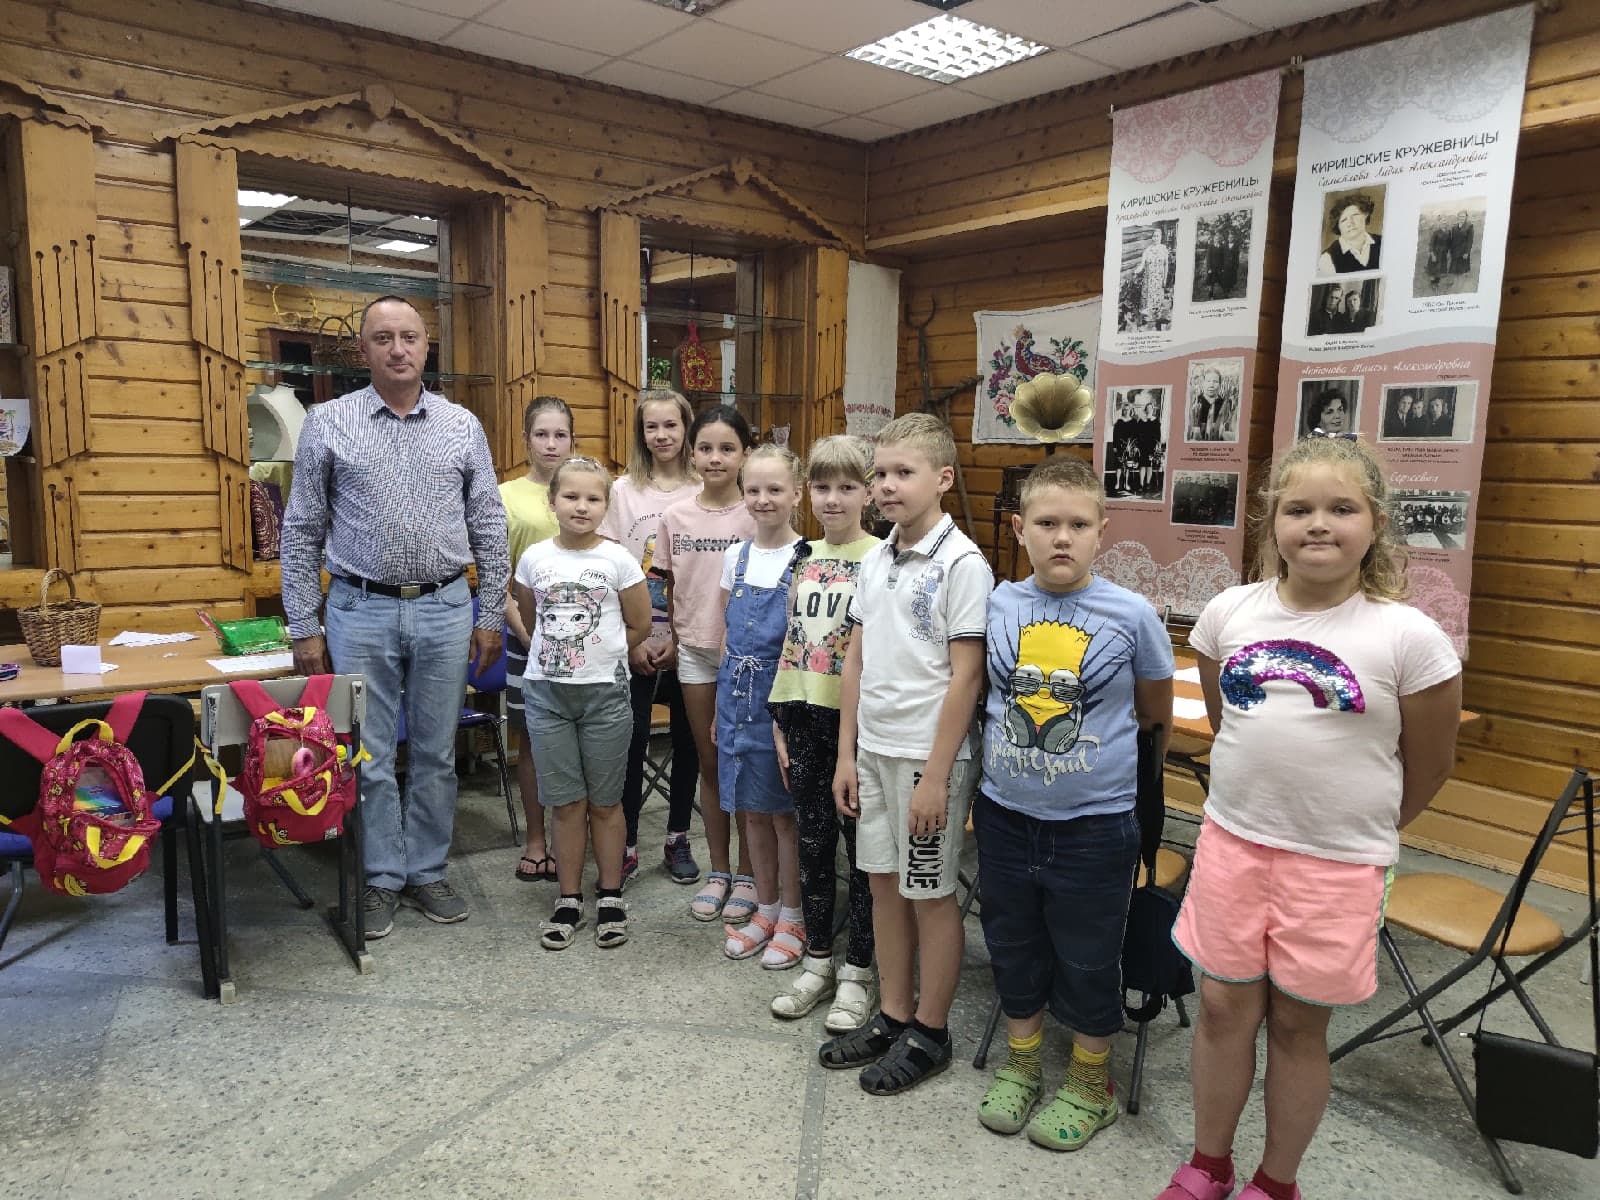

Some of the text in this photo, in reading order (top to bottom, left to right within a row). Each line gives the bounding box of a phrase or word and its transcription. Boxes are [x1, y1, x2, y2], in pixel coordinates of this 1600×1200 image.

[1311, 130, 1499, 174] КИРИШСКИЕ КРУЖЕВНИЦЫ
[1120, 189, 1181, 210] КИРИШСКИЕ
[1183, 176, 1259, 198] КРУЖЕВНИЦЫ
[793, 591, 854, 618] LOV
